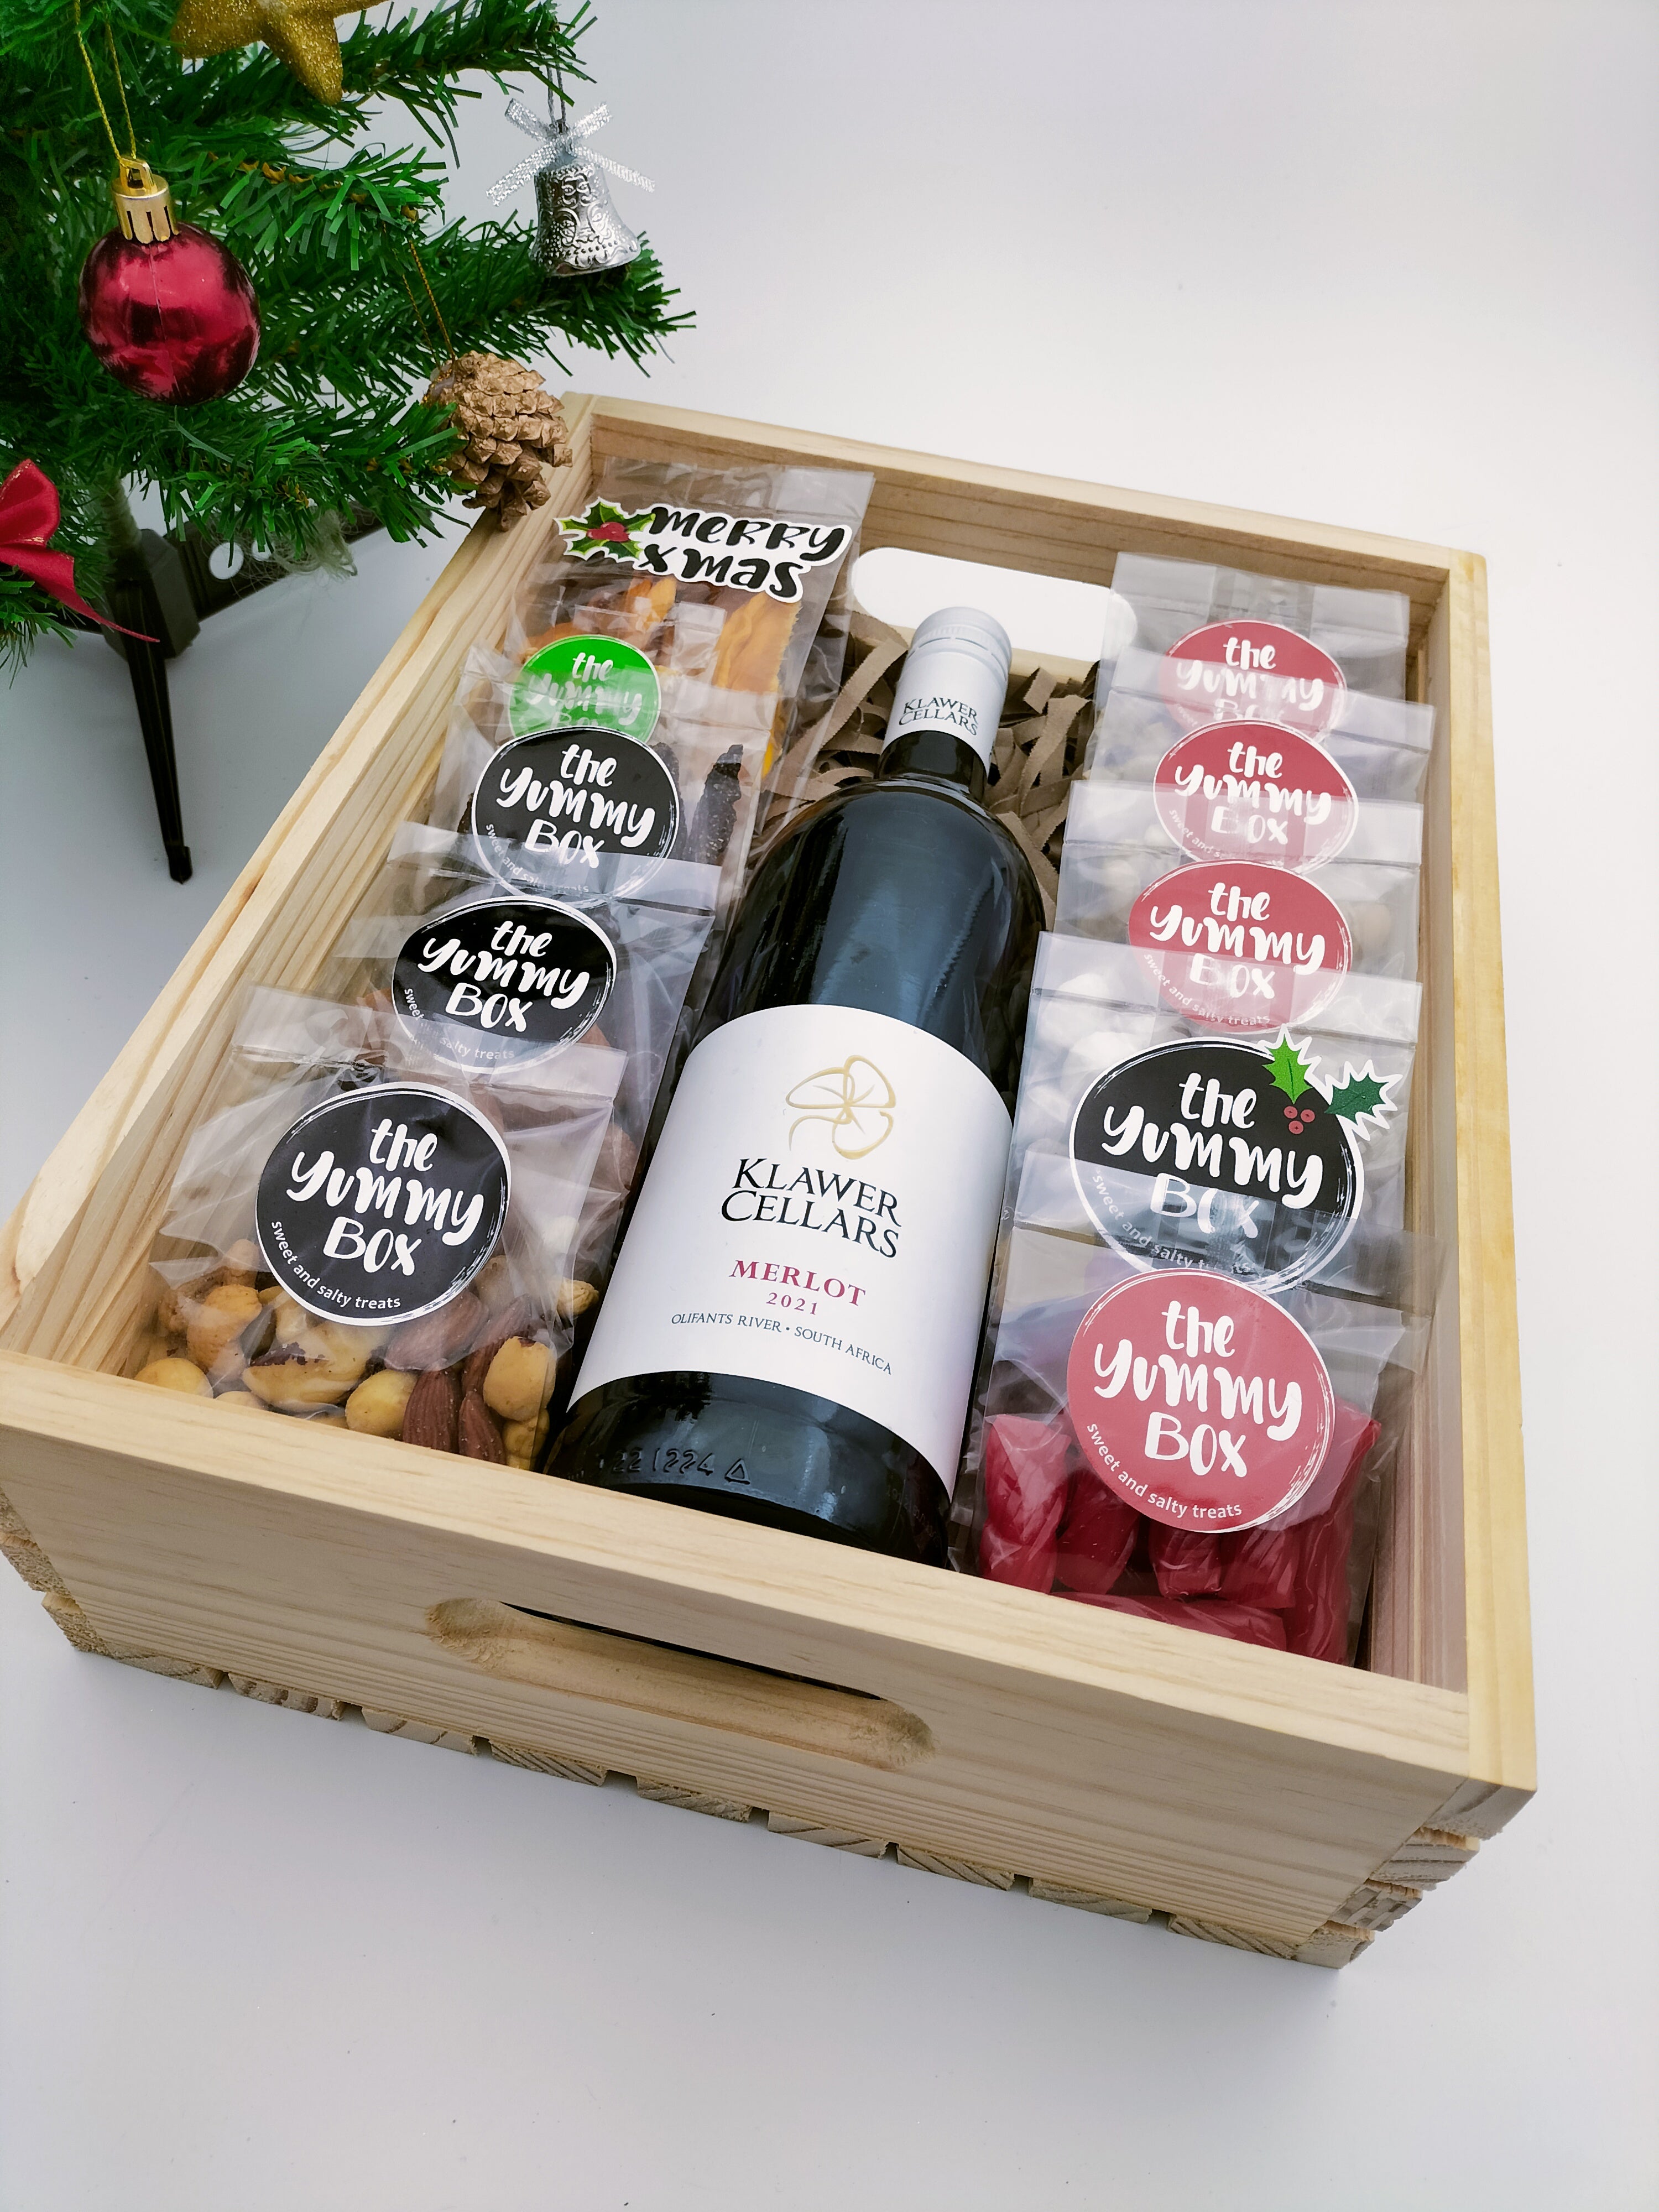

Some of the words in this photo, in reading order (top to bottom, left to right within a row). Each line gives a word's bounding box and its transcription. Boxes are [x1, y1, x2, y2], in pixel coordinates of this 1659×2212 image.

[572, 652, 613, 681] the
[1223, 637, 1276, 670] the
[899, 708, 978, 735] CELLARS
[904, 697, 978, 724] KLAWER
[561, 744, 617, 787] the
[1227, 742, 1282, 778] the
[503, 857, 523, 875] and
[1208, 883, 1270, 921] the
[491, 921, 552, 957] the
[1144, 954, 1170, 987] sweet
[1169, 985, 1191, 1006] and
[404, 988, 424, 1020] sweet
[476, 1048, 514, 1060] treats
[1179, 1072, 1256, 1129] the
[370, 1119, 437, 1171] the
[732, 1158, 901, 1227] KLAWER
[721, 1190, 899, 1258] CELLARS
[1093, 1175, 1124, 1220] sweet
[1122, 1221, 1152, 1248] and
[1153, 1244, 1193, 1268] salty
[271, 1220, 296, 1265] sweet
[293, 1262, 320, 1288] and
[317, 1285, 351, 1307] salty
[355, 1296, 400, 1309] treats
[729, 1260, 866, 1306] MERLOT
[766, 1292, 818, 1315] 2021
[671, 1313, 733, 1325] OLIFANTS
[737, 1315, 782, 1332] RIVER
[795, 1326, 842, 1351] SOUTH
[845, 1344, 893, 1375] AFRICA
[1161, 1301, 1235, 1357] the
[1087, 1423, 1120, 1472] sweet
[1118, 1471, 1148, 1497] and
[1147, 1493, 1187, 1518] salty
[1193, 1504, 1242, 1519] treats
